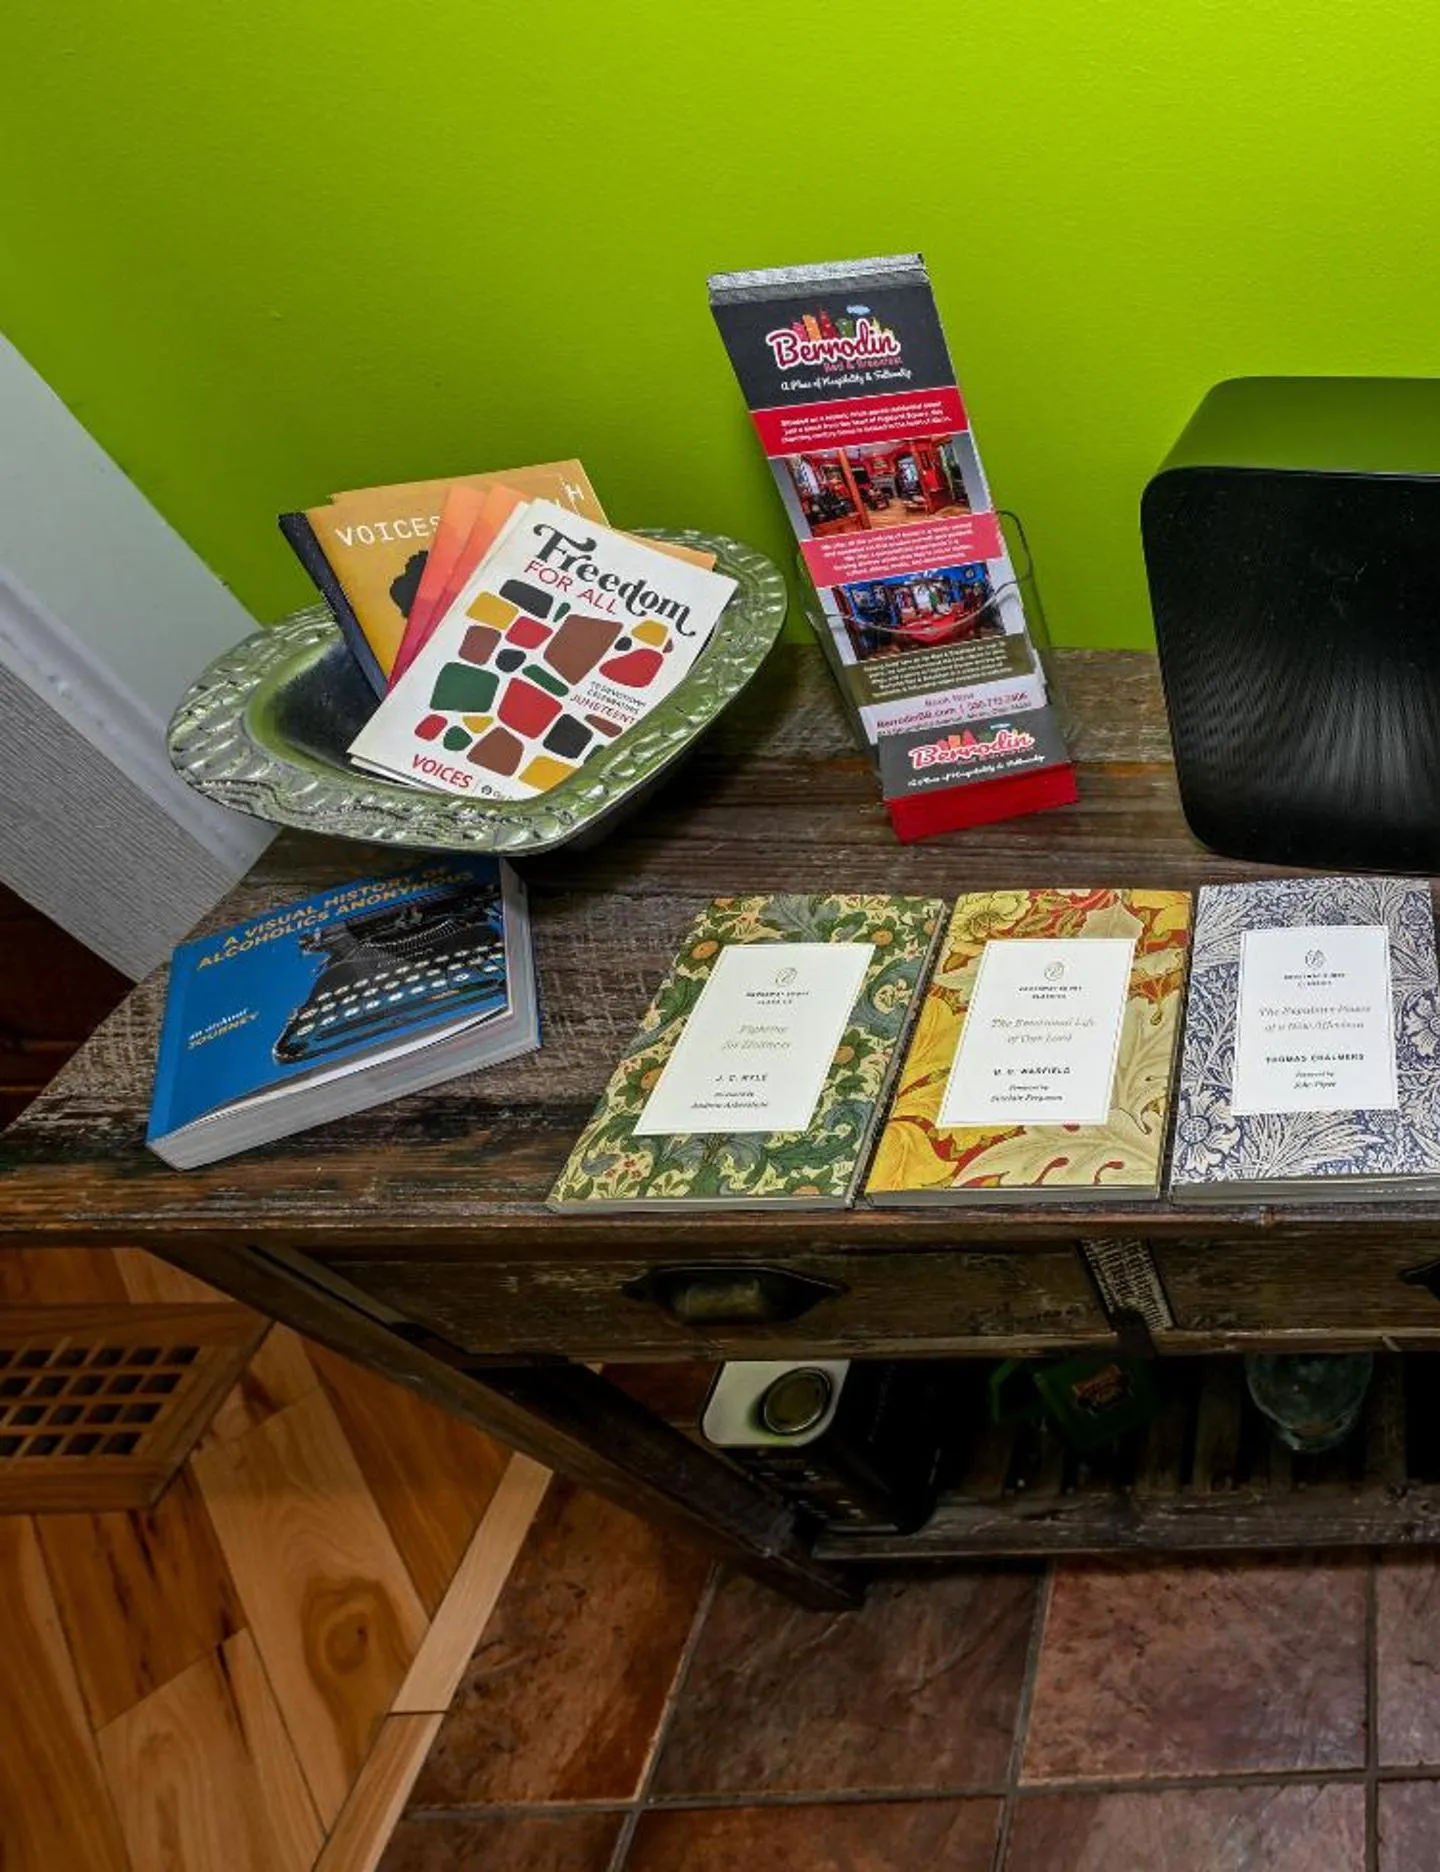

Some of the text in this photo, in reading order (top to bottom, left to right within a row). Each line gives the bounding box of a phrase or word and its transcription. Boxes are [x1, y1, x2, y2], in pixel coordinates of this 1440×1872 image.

[766, 318, 901, 369] Berrodin
[335, 516, 440, 546] VOICES
[524, 560, 619, 615] FOR ALL
[533, 524, 696, 637] Freedom
[412, 754, 473, 788] VOICES
[908, 729, 1035, 770] Berrodin
[196, 911, 329, 972] ALCOHOLICS
[223, 936, 239, 948] A
[244, 905, 317, 938] VISUAL
[1310, 1054, 1365, 1062] CHALMERS
